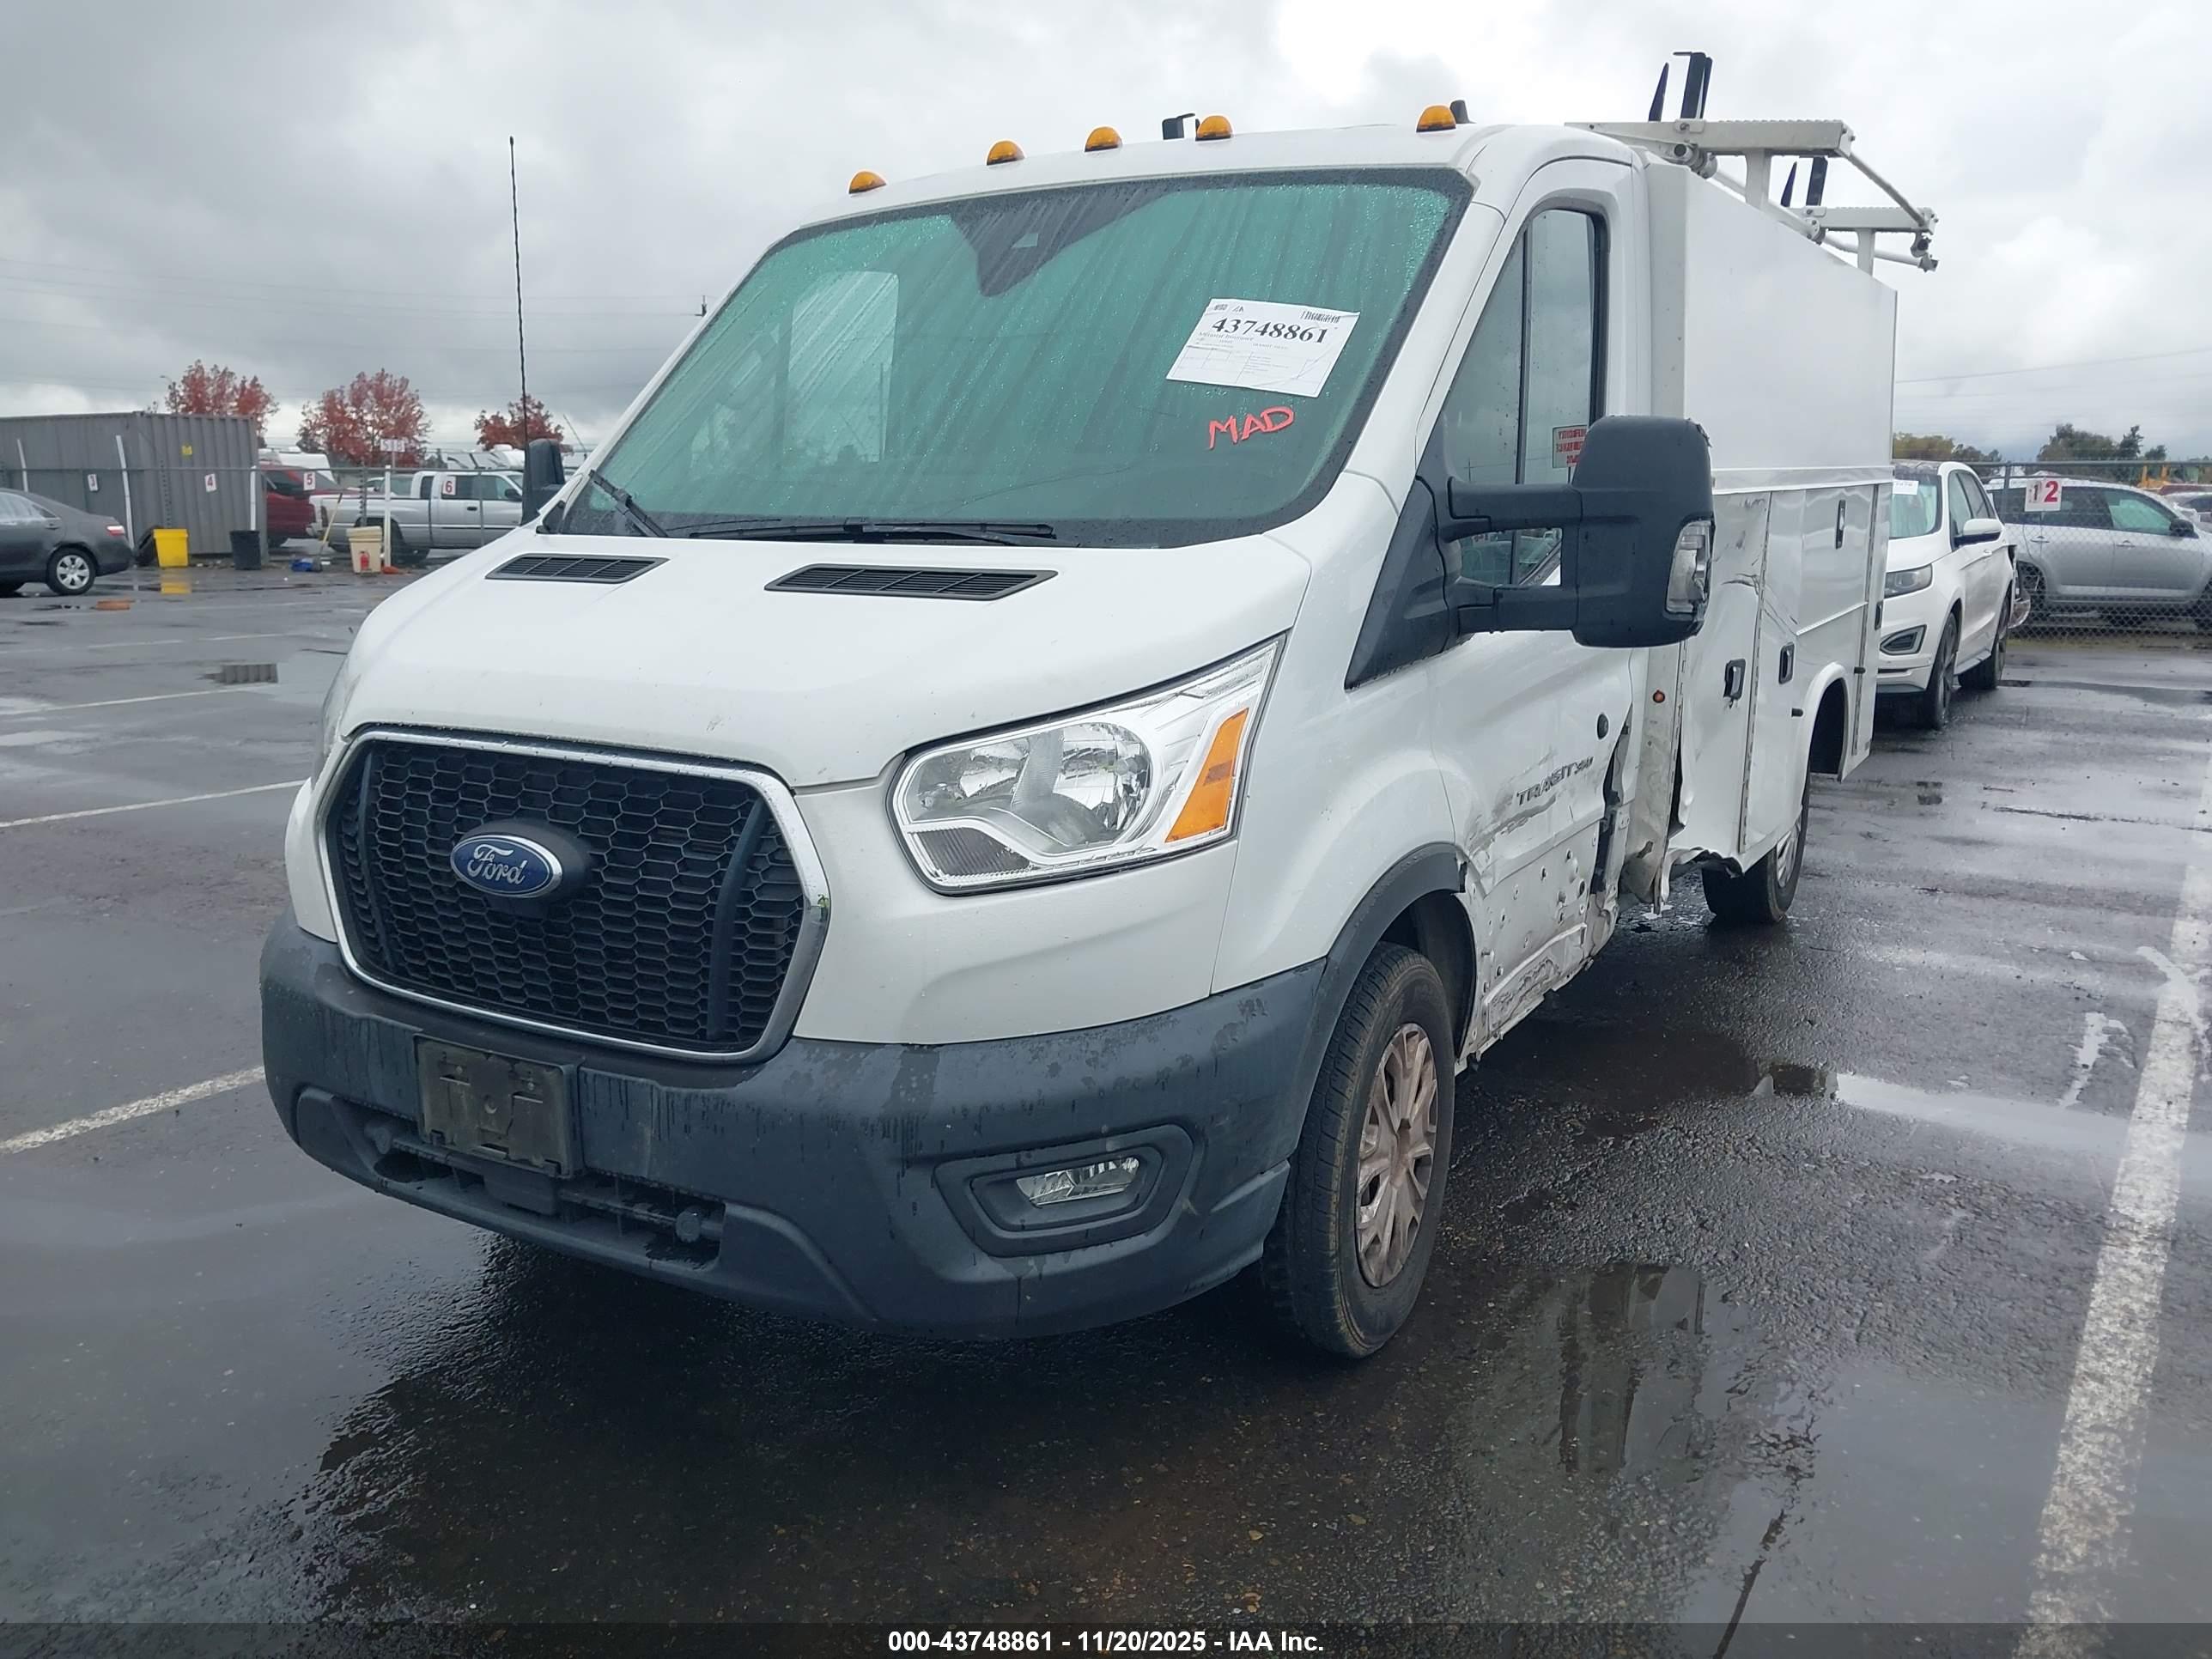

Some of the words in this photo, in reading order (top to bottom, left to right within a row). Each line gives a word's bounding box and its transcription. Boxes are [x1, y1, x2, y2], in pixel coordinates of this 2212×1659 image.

[1212, 317, 1329, 343] 43748861
[1207, 406, 1295, 450] MAD
[207, 477, 214, 487] 4
[307, 474, 313, 485] 5
[446, 481, 453, 493] 6
[1516, 763, 1576, 805] TRANSIT
[467, 843, 528, 885] Ford
